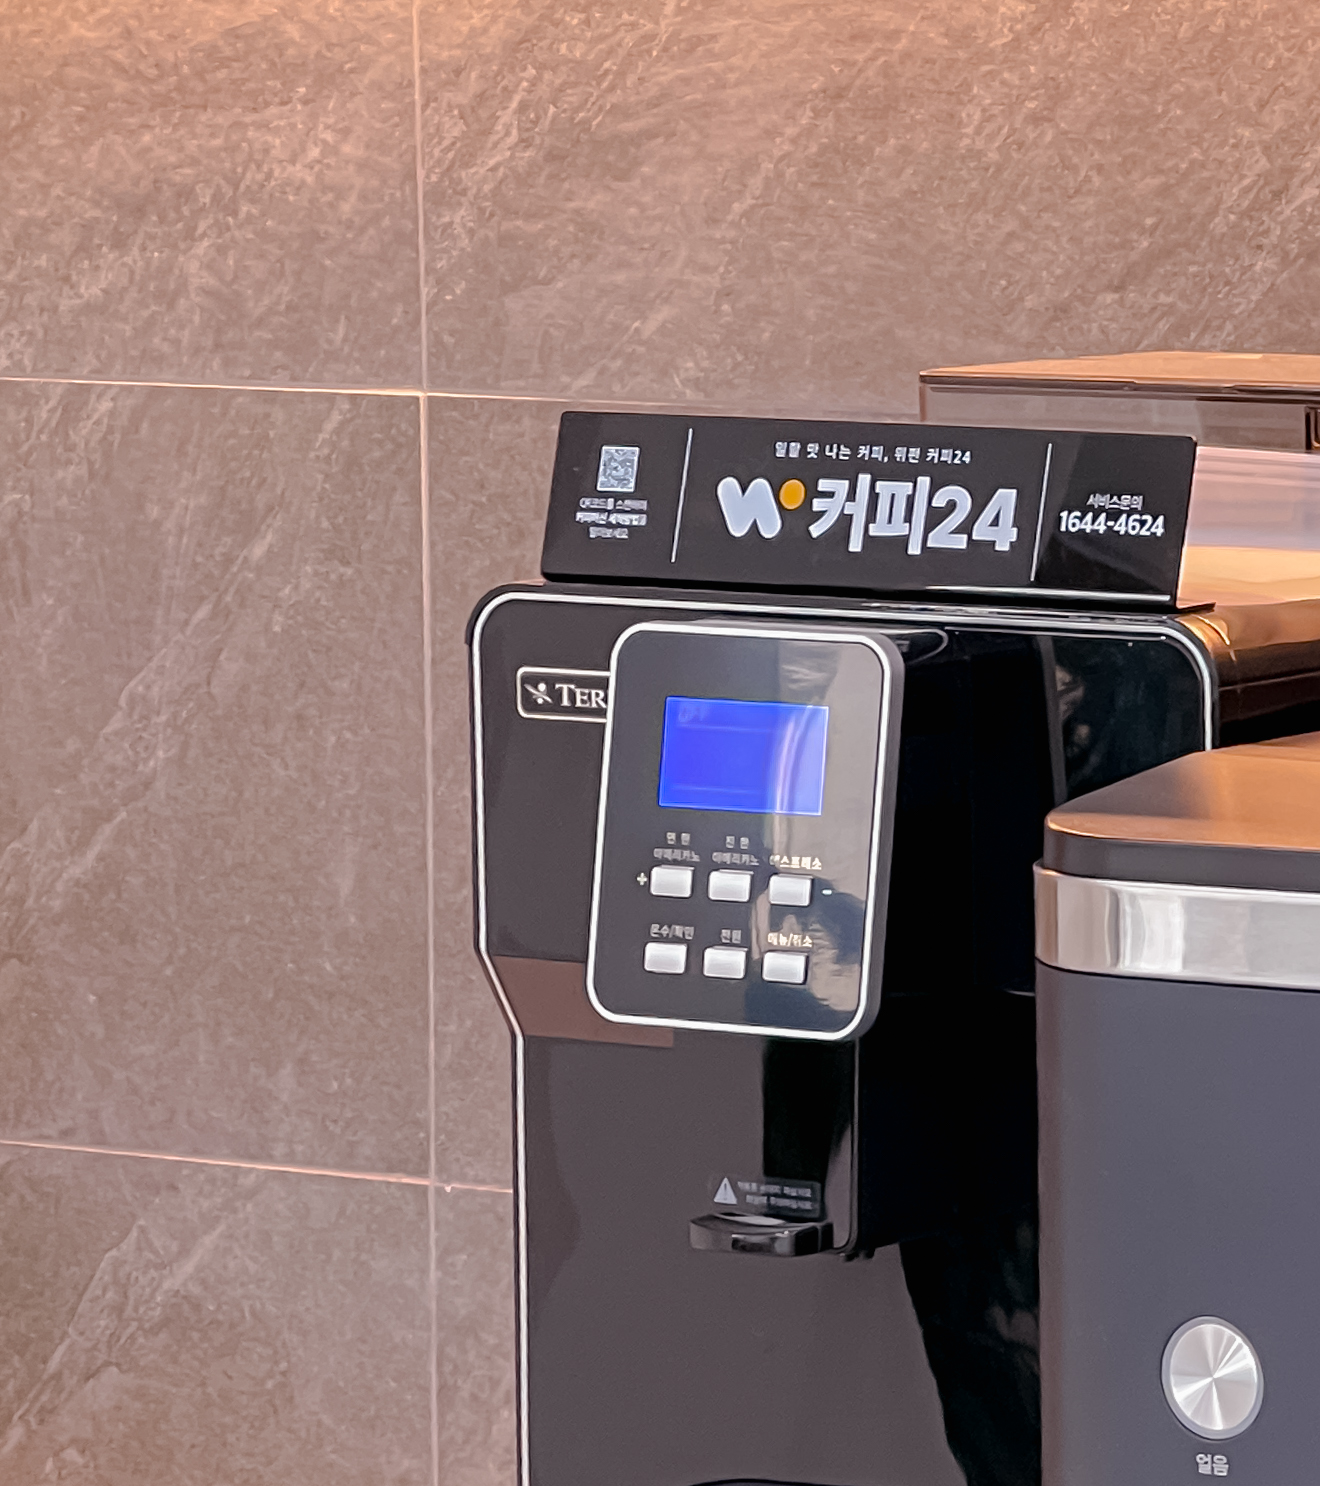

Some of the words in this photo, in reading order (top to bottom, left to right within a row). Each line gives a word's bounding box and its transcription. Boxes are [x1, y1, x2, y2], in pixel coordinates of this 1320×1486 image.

[807, 473, 1018, 556] 커피24
[1059, 510, 1165, 537] 1644-4624
[1195, 1453, 1229, 1476] 얼음
